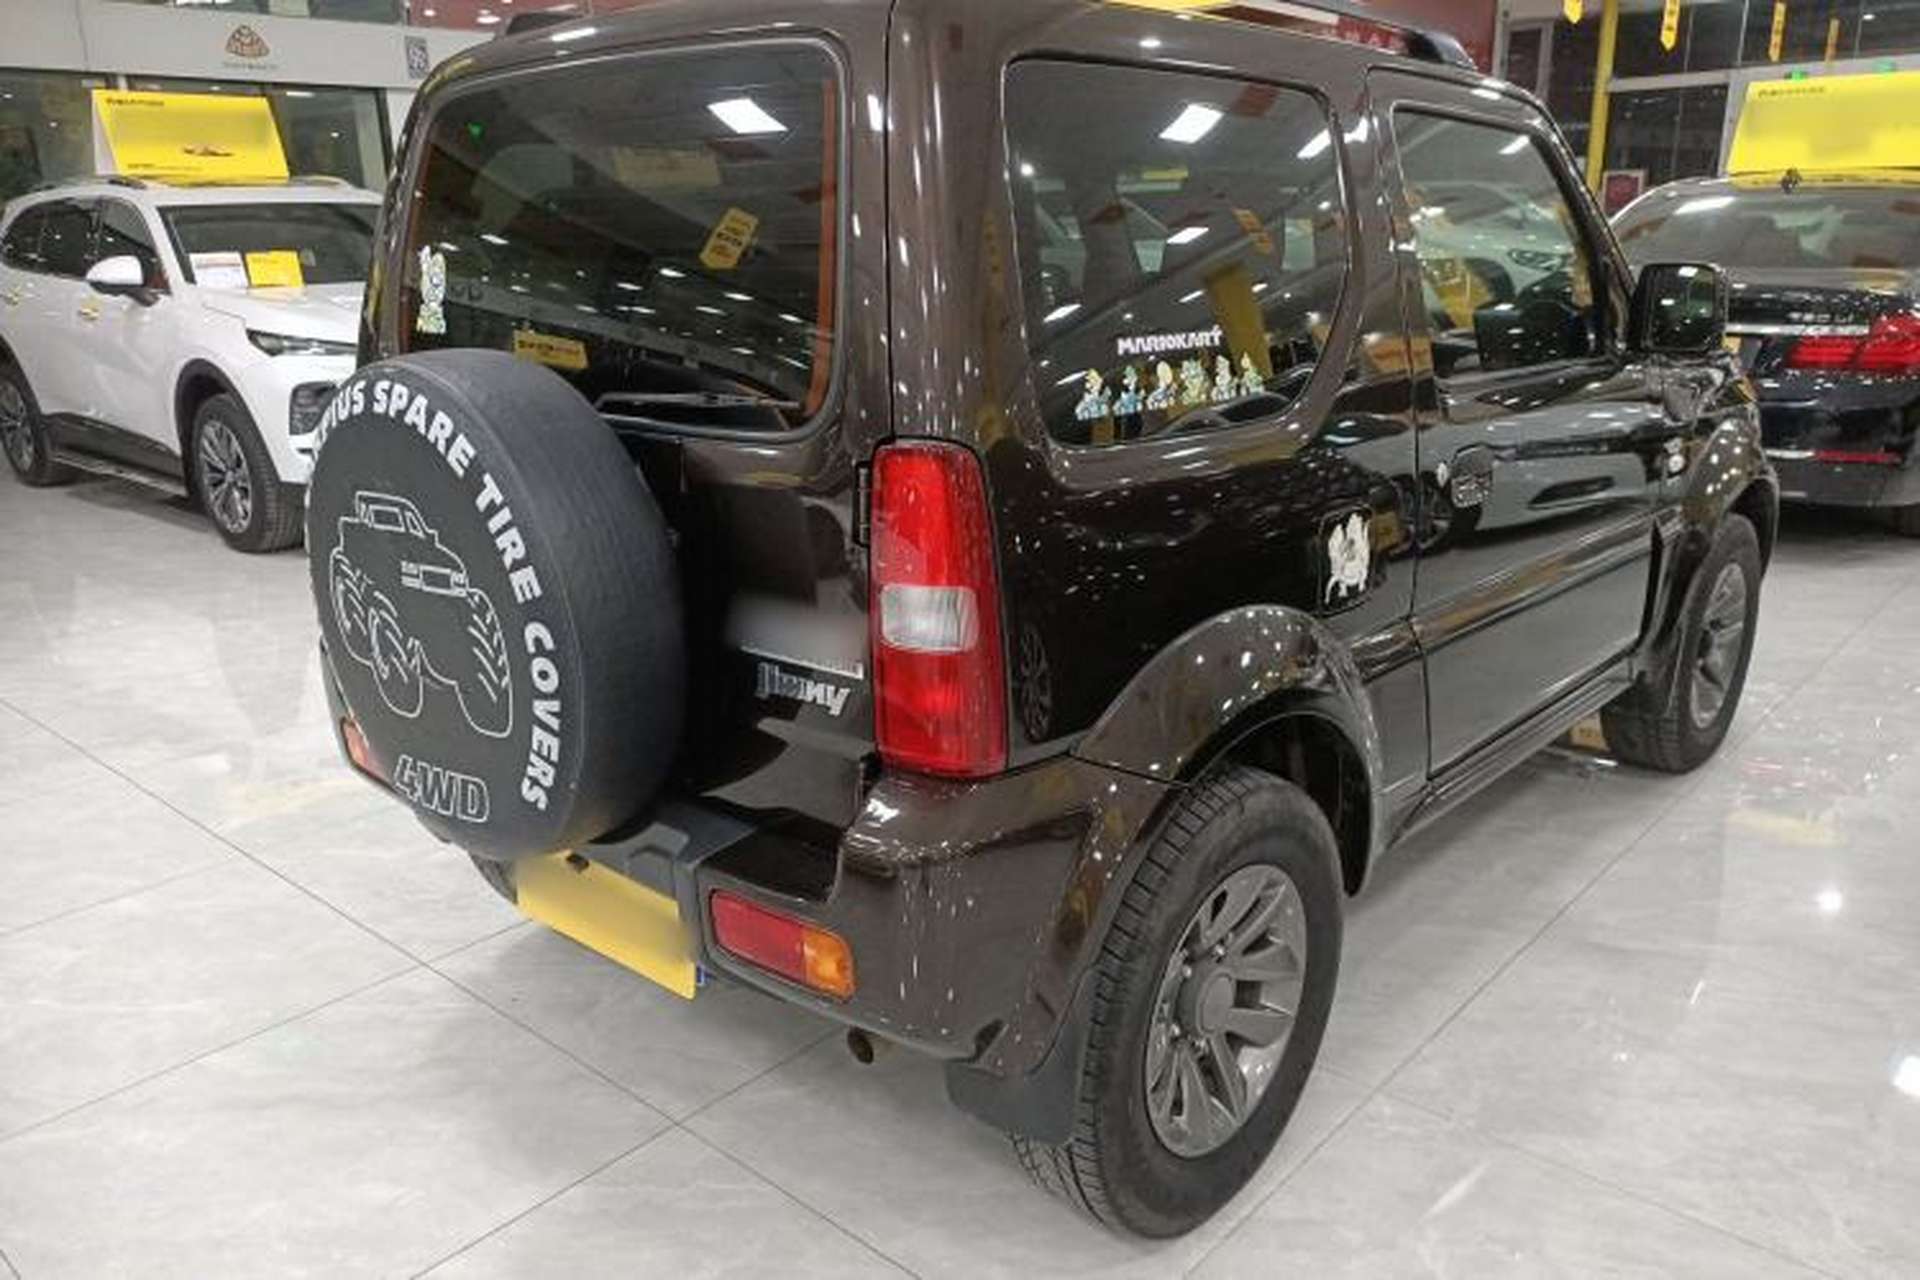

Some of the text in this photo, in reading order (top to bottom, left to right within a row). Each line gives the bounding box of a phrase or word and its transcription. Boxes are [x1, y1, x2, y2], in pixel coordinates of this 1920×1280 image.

[372, 379, 476, 478] SPARE
[474, 473, 542, 603] TIRE
[519, 620, 561, 811] COVERS
[394, 753, 490, 823] 4WD
